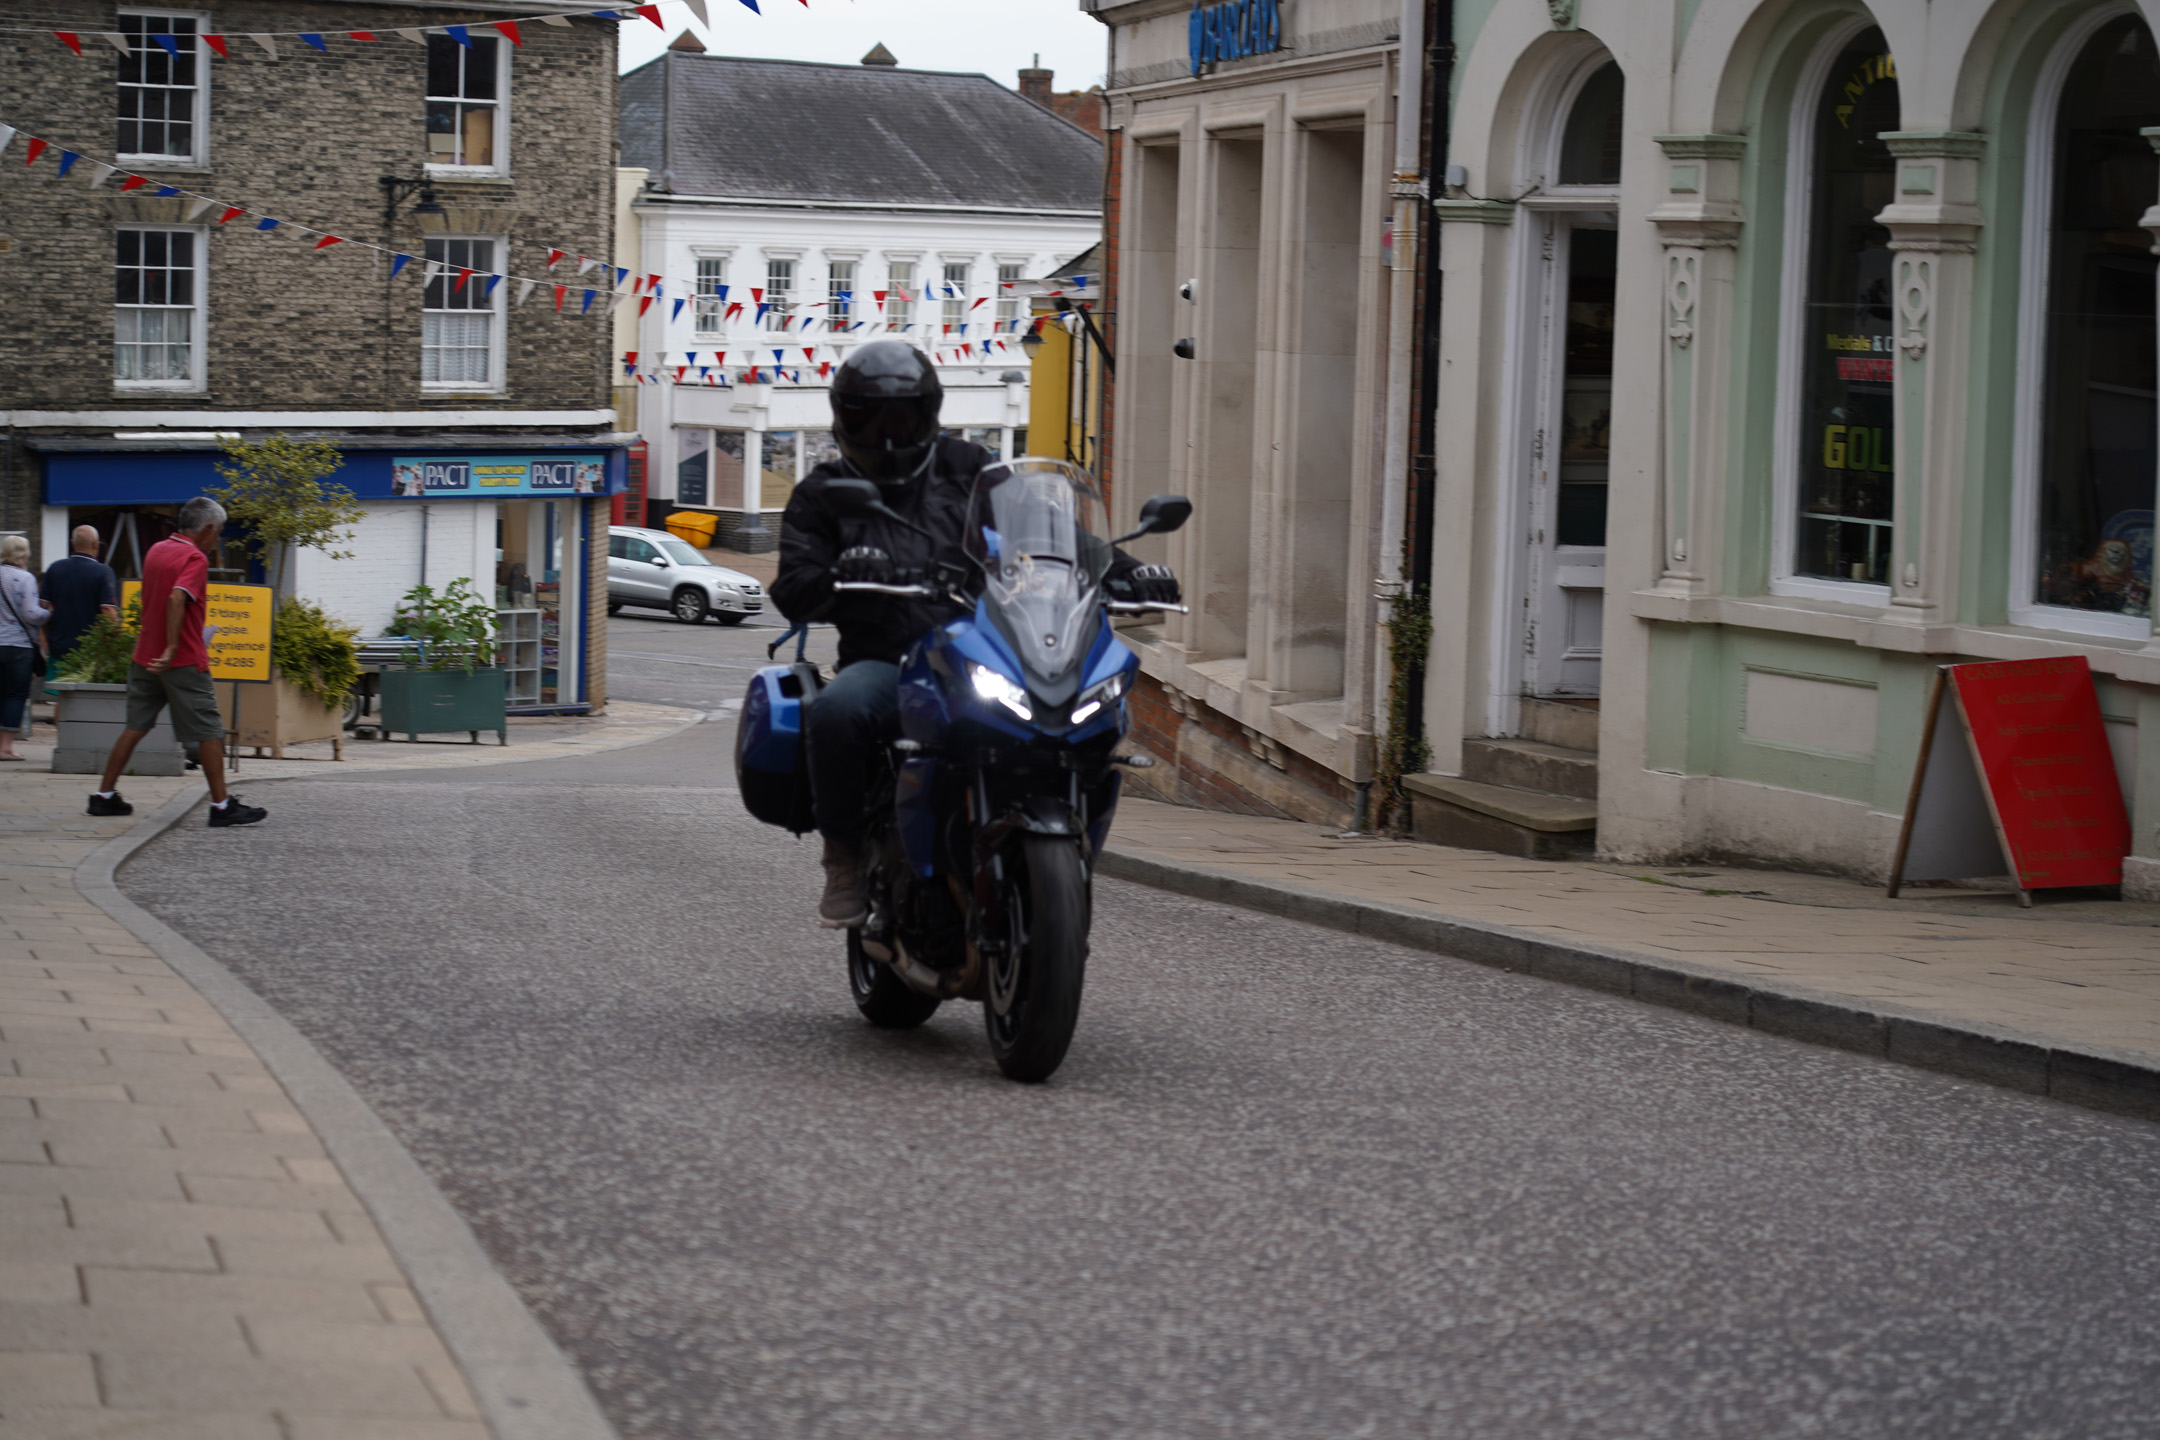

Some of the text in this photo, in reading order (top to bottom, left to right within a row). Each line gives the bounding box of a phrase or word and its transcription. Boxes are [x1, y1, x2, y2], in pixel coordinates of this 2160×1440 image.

[1823, 424, 1895, 472] GOL
[425, 465, 469, 486] PACT
[532, 464, 575, 485] PACT
[224, 593, 253, 603] Here
[209, 608, 217, 618] 5
[224, 657, 256, 668] 4285
[1963, 665, 2004, 680] CASH
[2005, 661, 2043, 678] PAID
